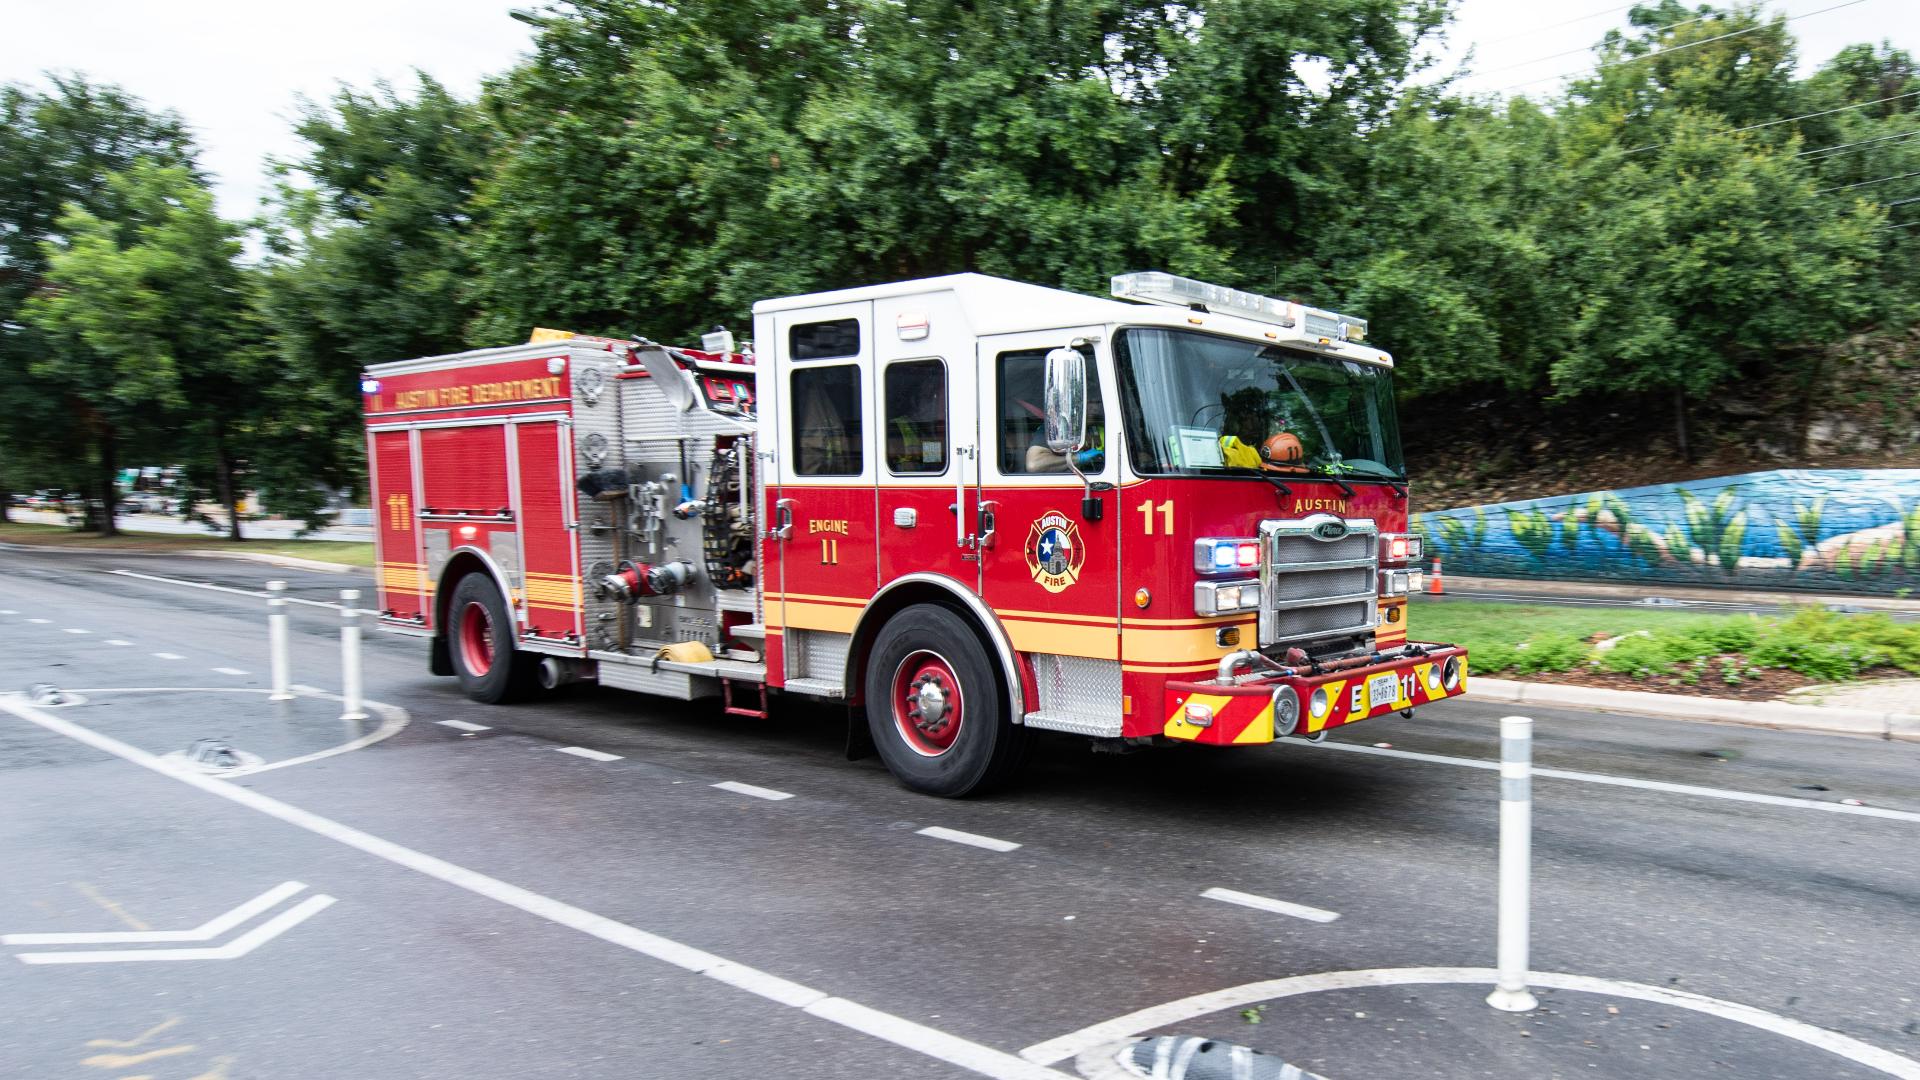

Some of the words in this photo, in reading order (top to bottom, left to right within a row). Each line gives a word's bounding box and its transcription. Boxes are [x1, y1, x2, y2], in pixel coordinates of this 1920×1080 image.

[395, 389, 439, 410] AUSTIN
[439, 385, 470, 406] FIRE
[471, 377, 560, 403] DEPARTMENT
[386, 493, 410, 531] 11
[1137, 499, 1174, 535] 11
[1294, 498, 1346, 514] AUSTIN
[809, 519, 849, 536] ENGINE
[1041, 515, 1067, 530] AUSTIN
[821, 539, 838, 565] 11
[1043, 575, 1067, 587] FIRE
[1351, 684, 1364, 713] E
[1400, 672, 1416, 700] 11
